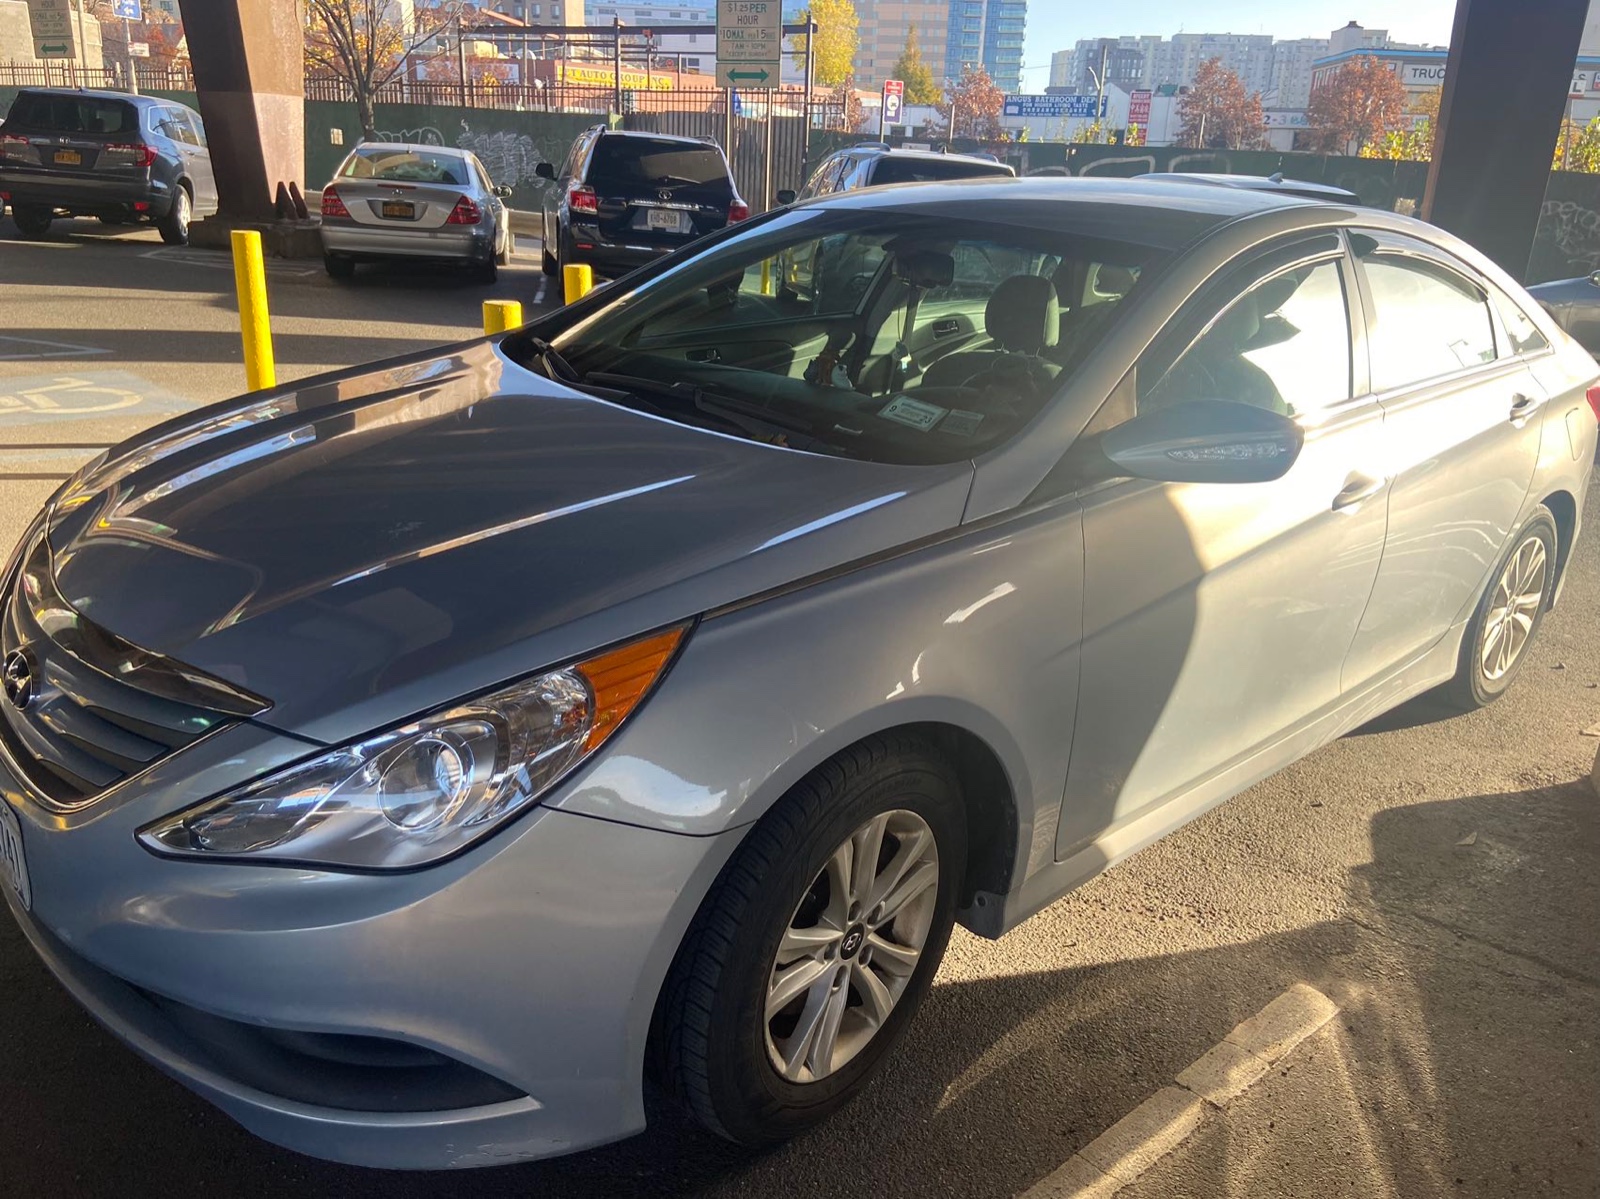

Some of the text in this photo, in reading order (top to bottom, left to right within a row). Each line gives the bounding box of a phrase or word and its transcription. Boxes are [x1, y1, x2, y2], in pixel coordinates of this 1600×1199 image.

[750, 4, 767, 13] PER
[737, 15, 759, 25] HOUR
[580, 70, 607, 80] AUTO
[1006, 95, 1032, 103] ANGUS
[1080, 96, 1107, 104] DEPT
